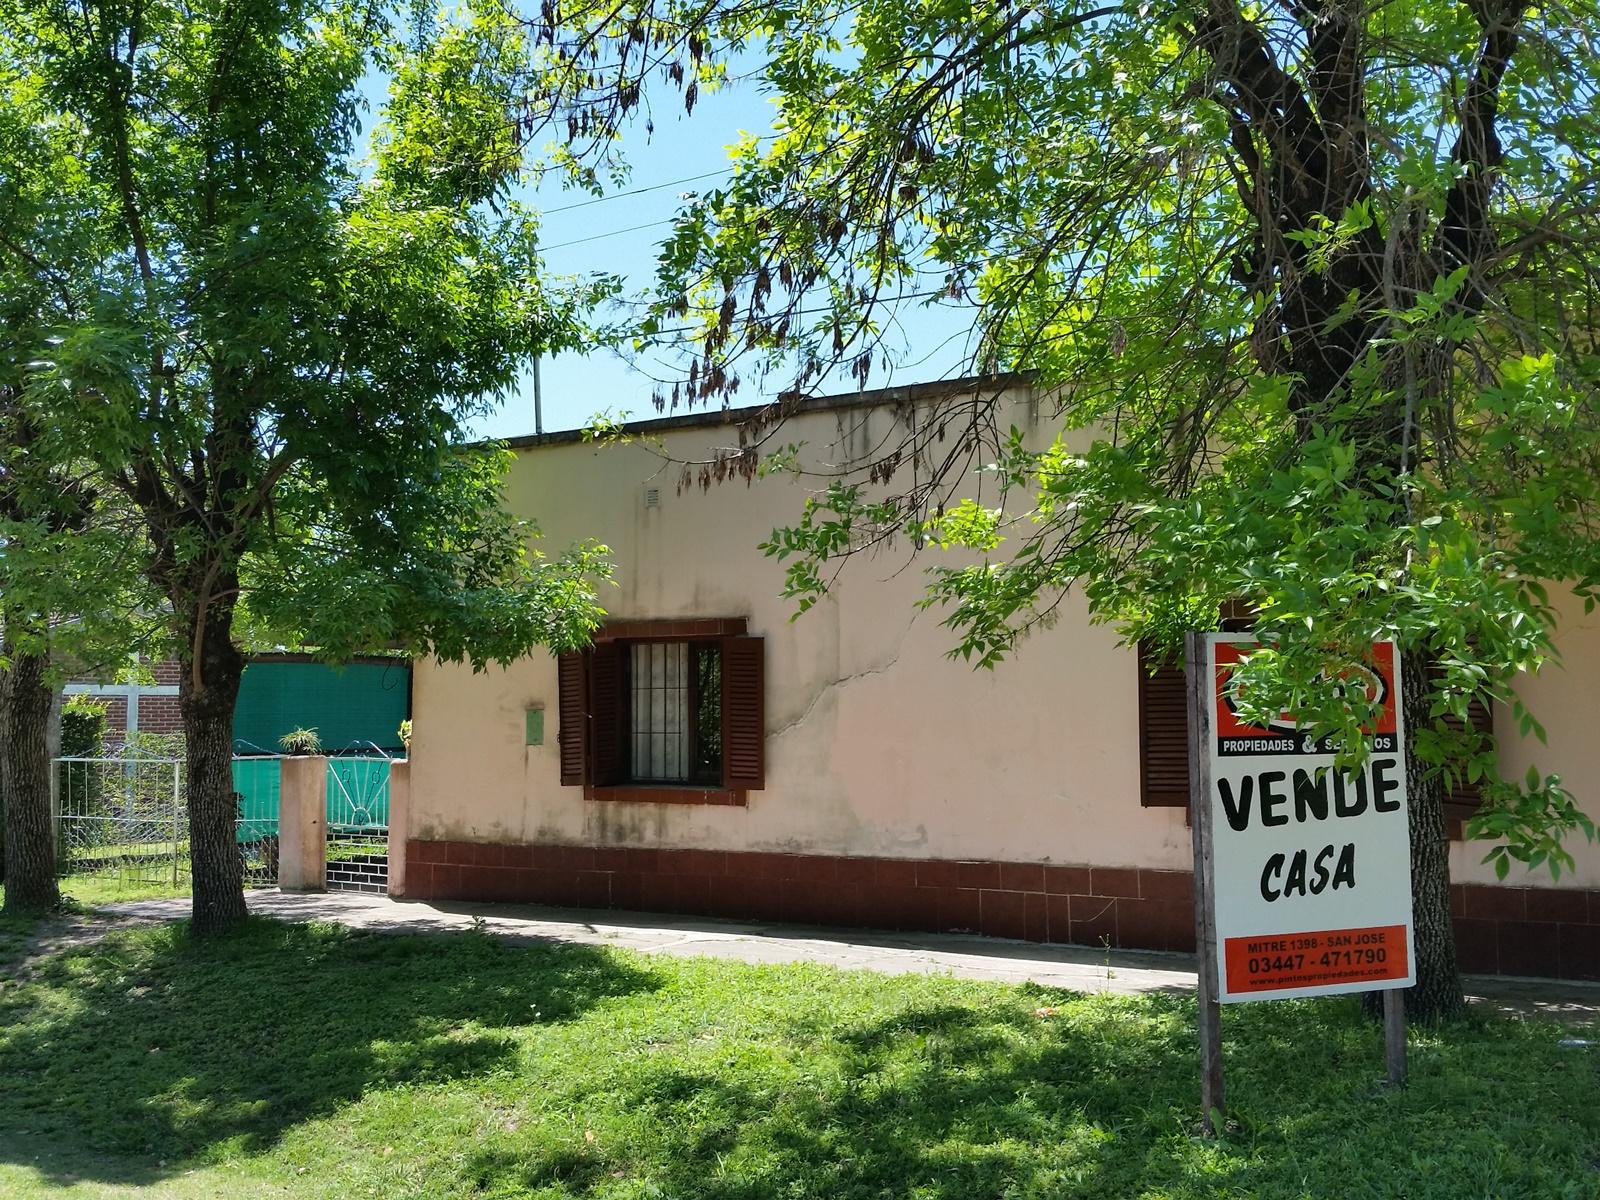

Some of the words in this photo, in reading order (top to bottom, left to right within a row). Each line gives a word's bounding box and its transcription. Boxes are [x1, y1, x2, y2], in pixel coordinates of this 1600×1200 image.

[1223, 739, 1294, 752] PROPIEDADES
[1217, 758, 1401, 831] VENDE
[1260, 842, 1356, 903] CASA
[1248, 941, 1286, 953] MITRE
[1290, 937, 1318, 951] 1398
[1327, 936, 1352, 947] SAN
[1356, 932, 1385, 945] JOSE
[1248, 954, 1305, 974] 03447
[1319, 948, 1387, 968] 471790
[1249, 968, 1388, 985] www.pintospropiedades.com
